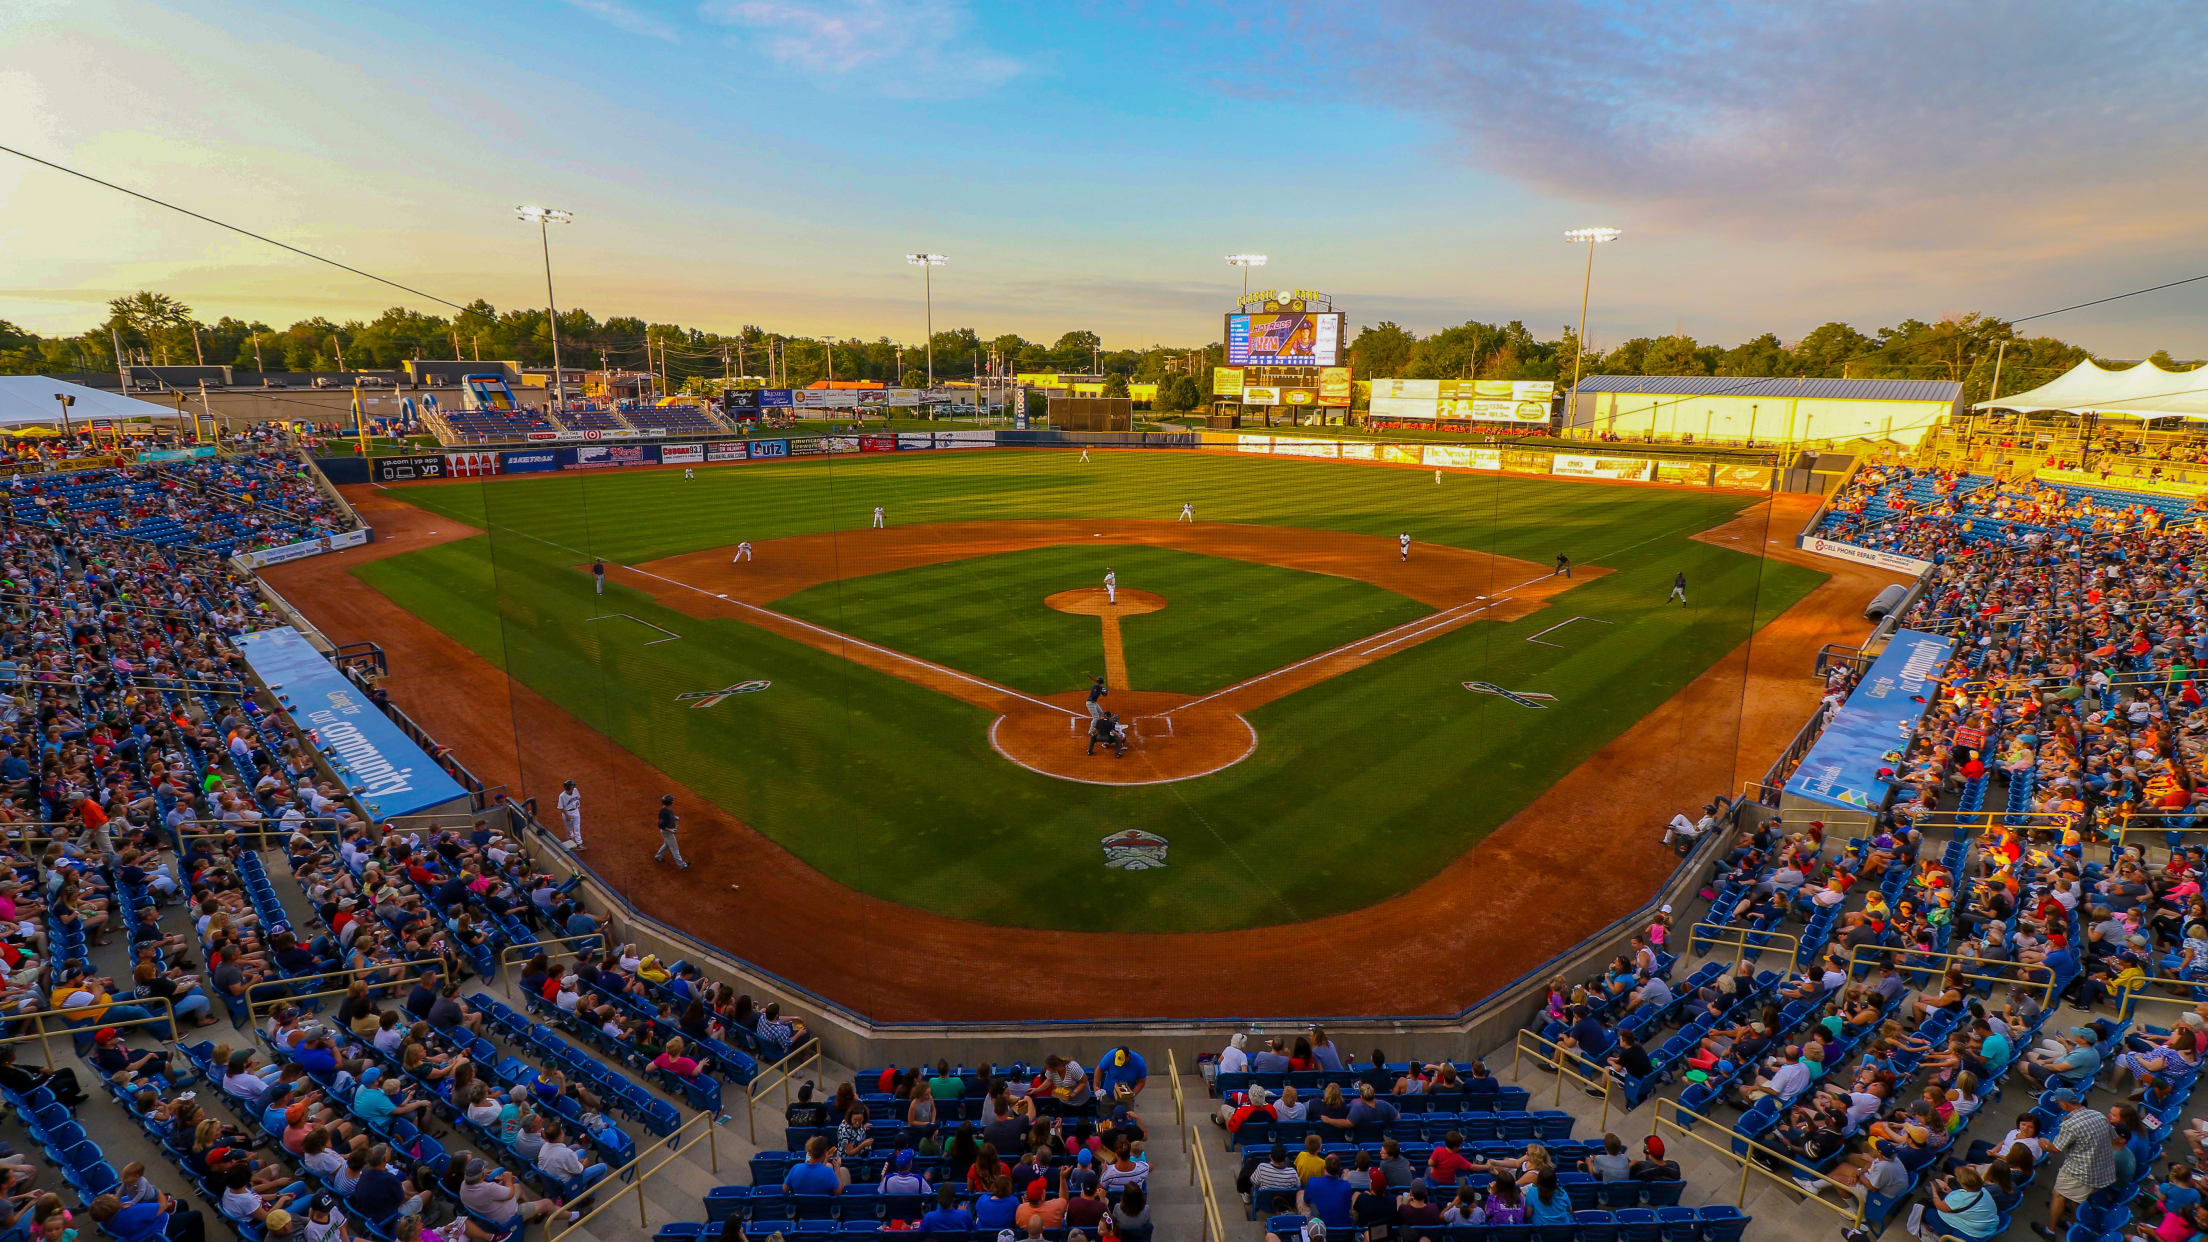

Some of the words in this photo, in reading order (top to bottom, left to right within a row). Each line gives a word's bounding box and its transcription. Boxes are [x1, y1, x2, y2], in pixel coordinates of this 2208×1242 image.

[1237, 289, 1276, 307] CLASSIC
[1294, 289, 1319, 301] PARK
[690, 446, 702, 454] 93.7
[422, 465, 439, 474] yp
[1837, 547, 1856, 555] PHONE
[1857, 551, 1876, 560] REPAIR
[1898, 639, 1950, 681] community
[1864, 684, 1896, 699] Caring
[1899, 679, 1923, 693] our
[325, 689, 347, 710] Caring
[342, 704, 361, 715] for
[308, 709, 328, 724] our
[320, 721, 413, 797] community
